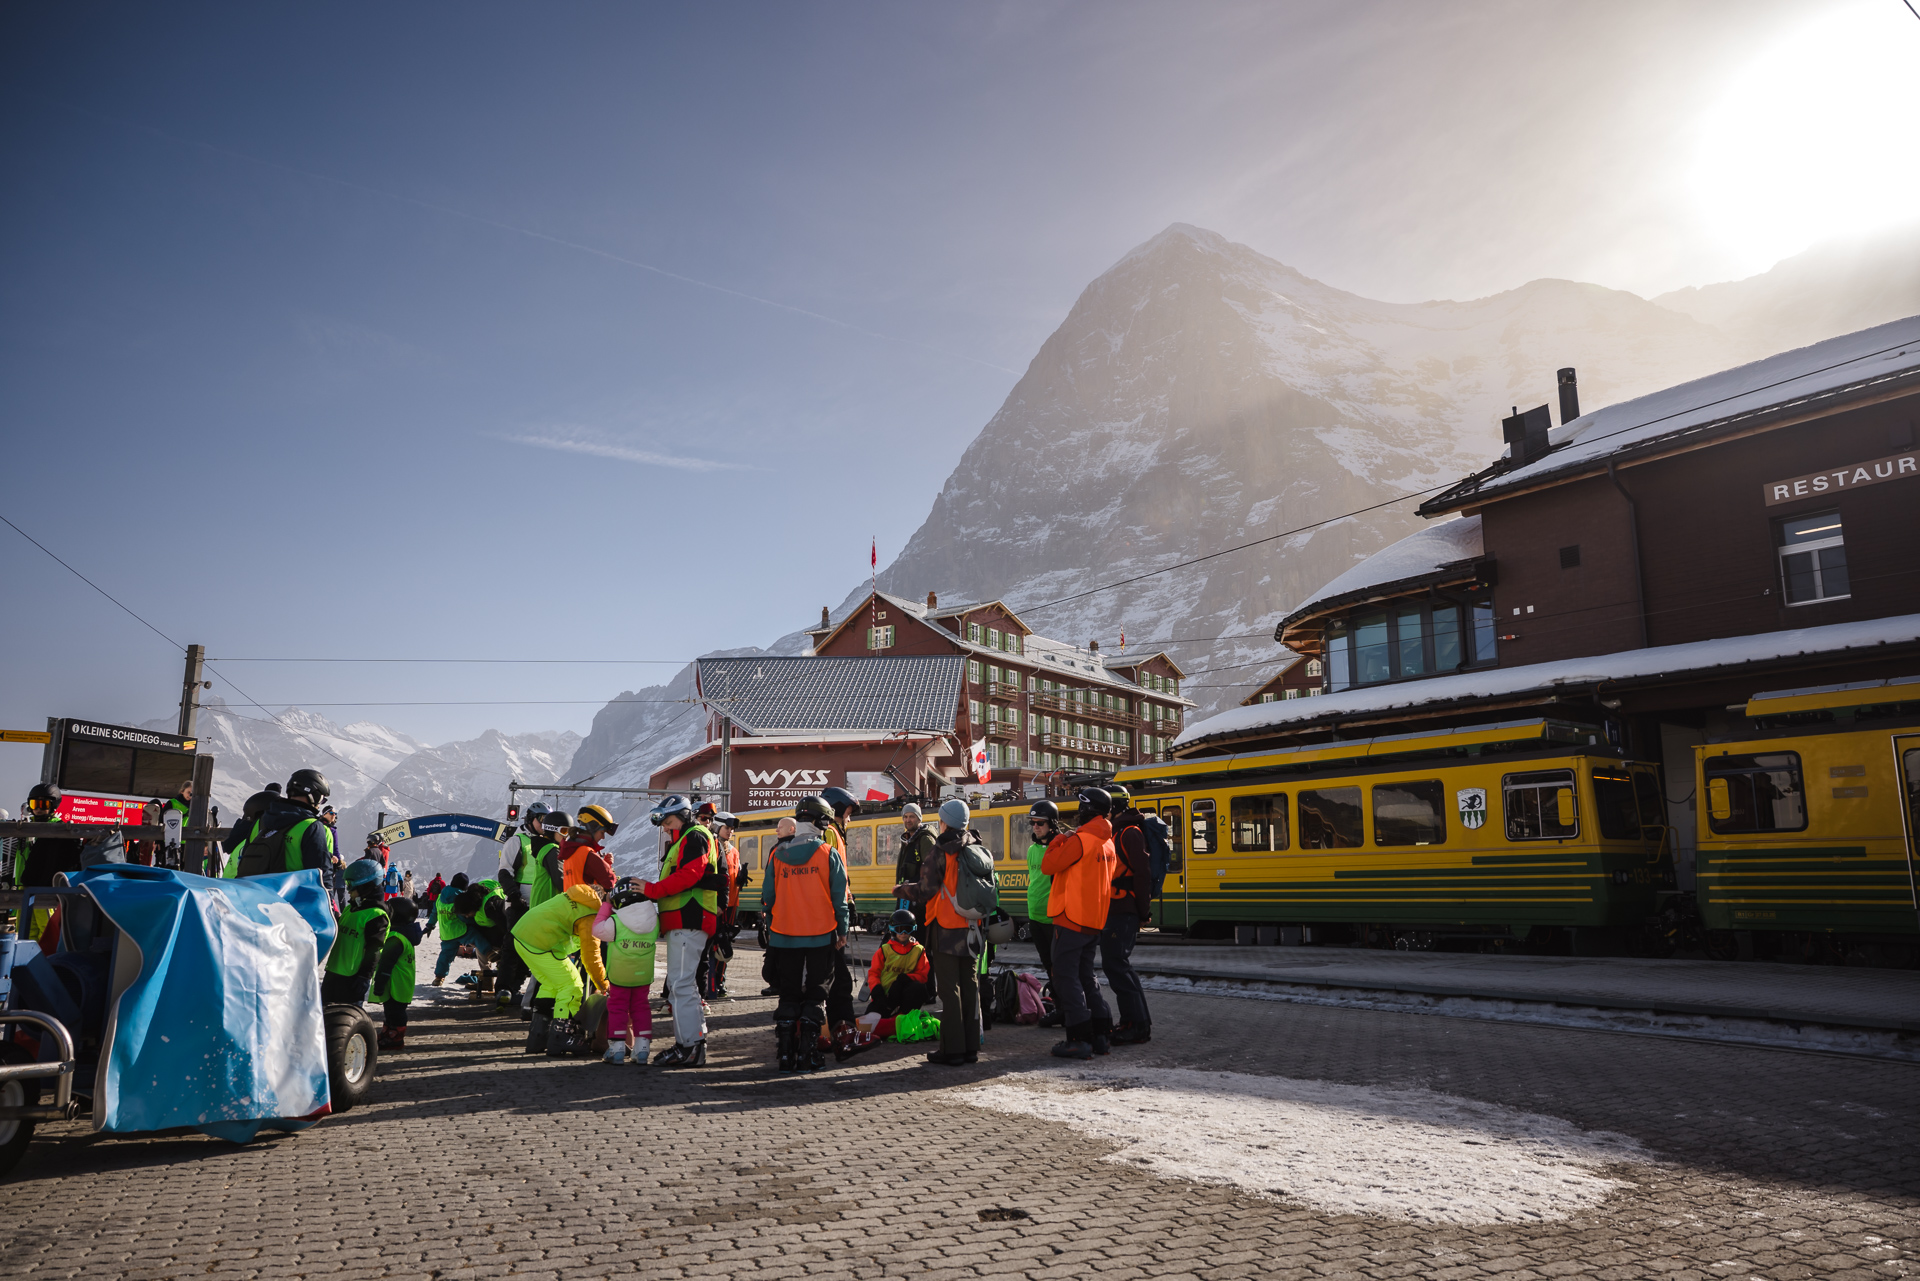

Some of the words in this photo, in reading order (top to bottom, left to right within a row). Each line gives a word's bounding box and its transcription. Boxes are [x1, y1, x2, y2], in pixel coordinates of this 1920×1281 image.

[1773, 456, 1917, 501] RESTAUR
[80, 725, 111, 738] KLEINE
[112, 729, 160, 745] SCHEIDEGG
[1061, 736, 1121, 756] BELLEVUE
[748, 790, 775, 798] SPORT
[73, 798, 99, 806] Männlichen
[748, 799, 761, 807] SKI
[763, 799, 770, 807] &
[71, 814, 87, 822] Honegg
[1219, 814, 1227, 828] 2
[459, 822, 493, 832] Grindelwald
[1633, 867, 1651, 884] 133
